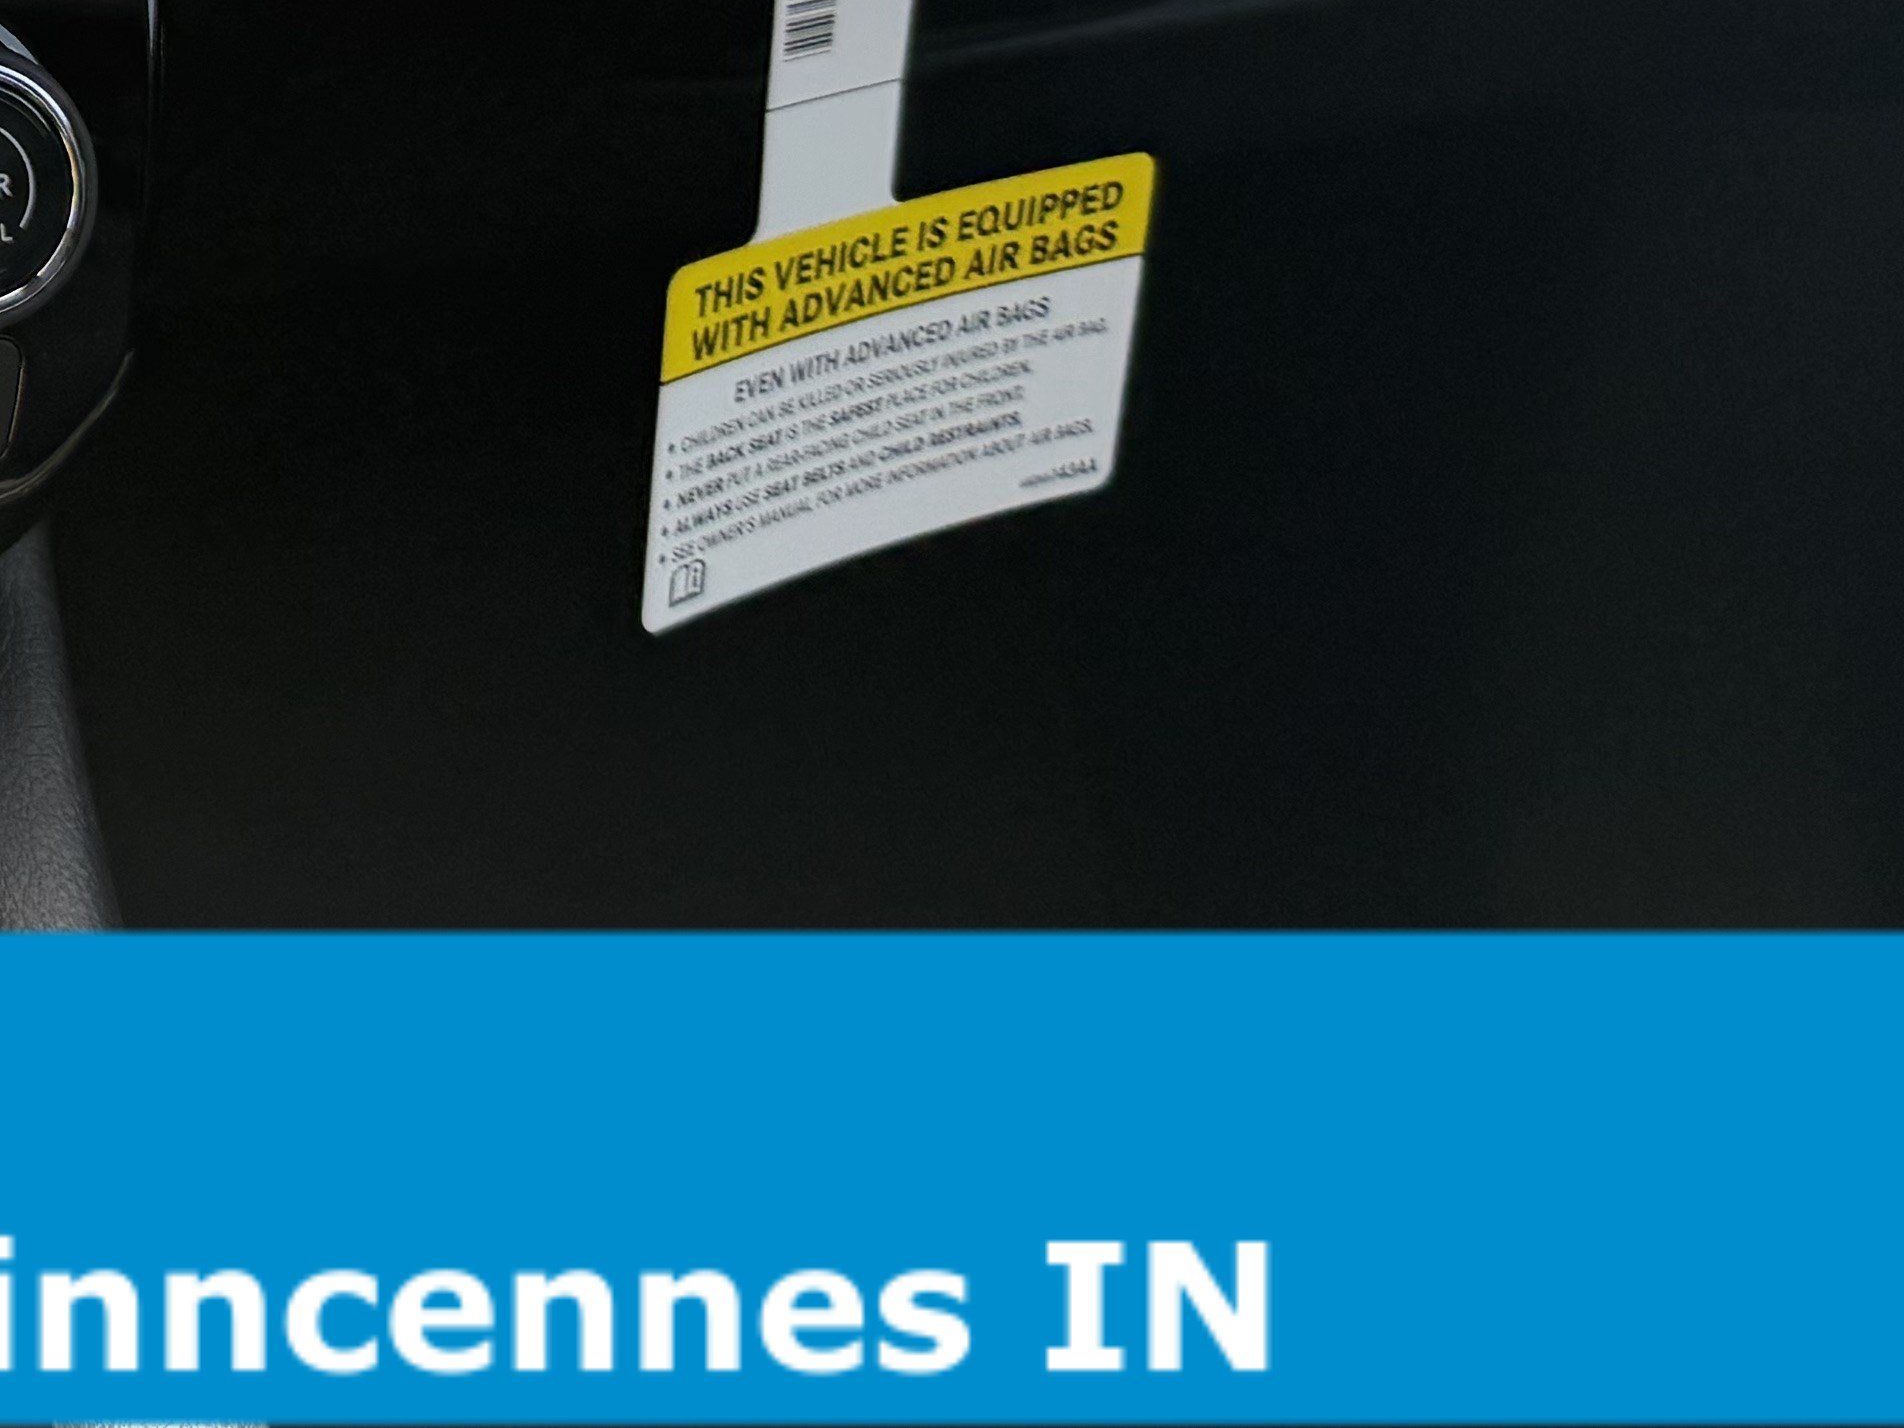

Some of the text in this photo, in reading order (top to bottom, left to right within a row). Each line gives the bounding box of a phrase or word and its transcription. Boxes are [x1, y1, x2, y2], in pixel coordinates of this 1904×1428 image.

[693, 219, 1118, 361] WITH ADVANCED AIR BAGS
[695, 181, 1123, 317] THIS VEHICLE IS EQUIPPED
